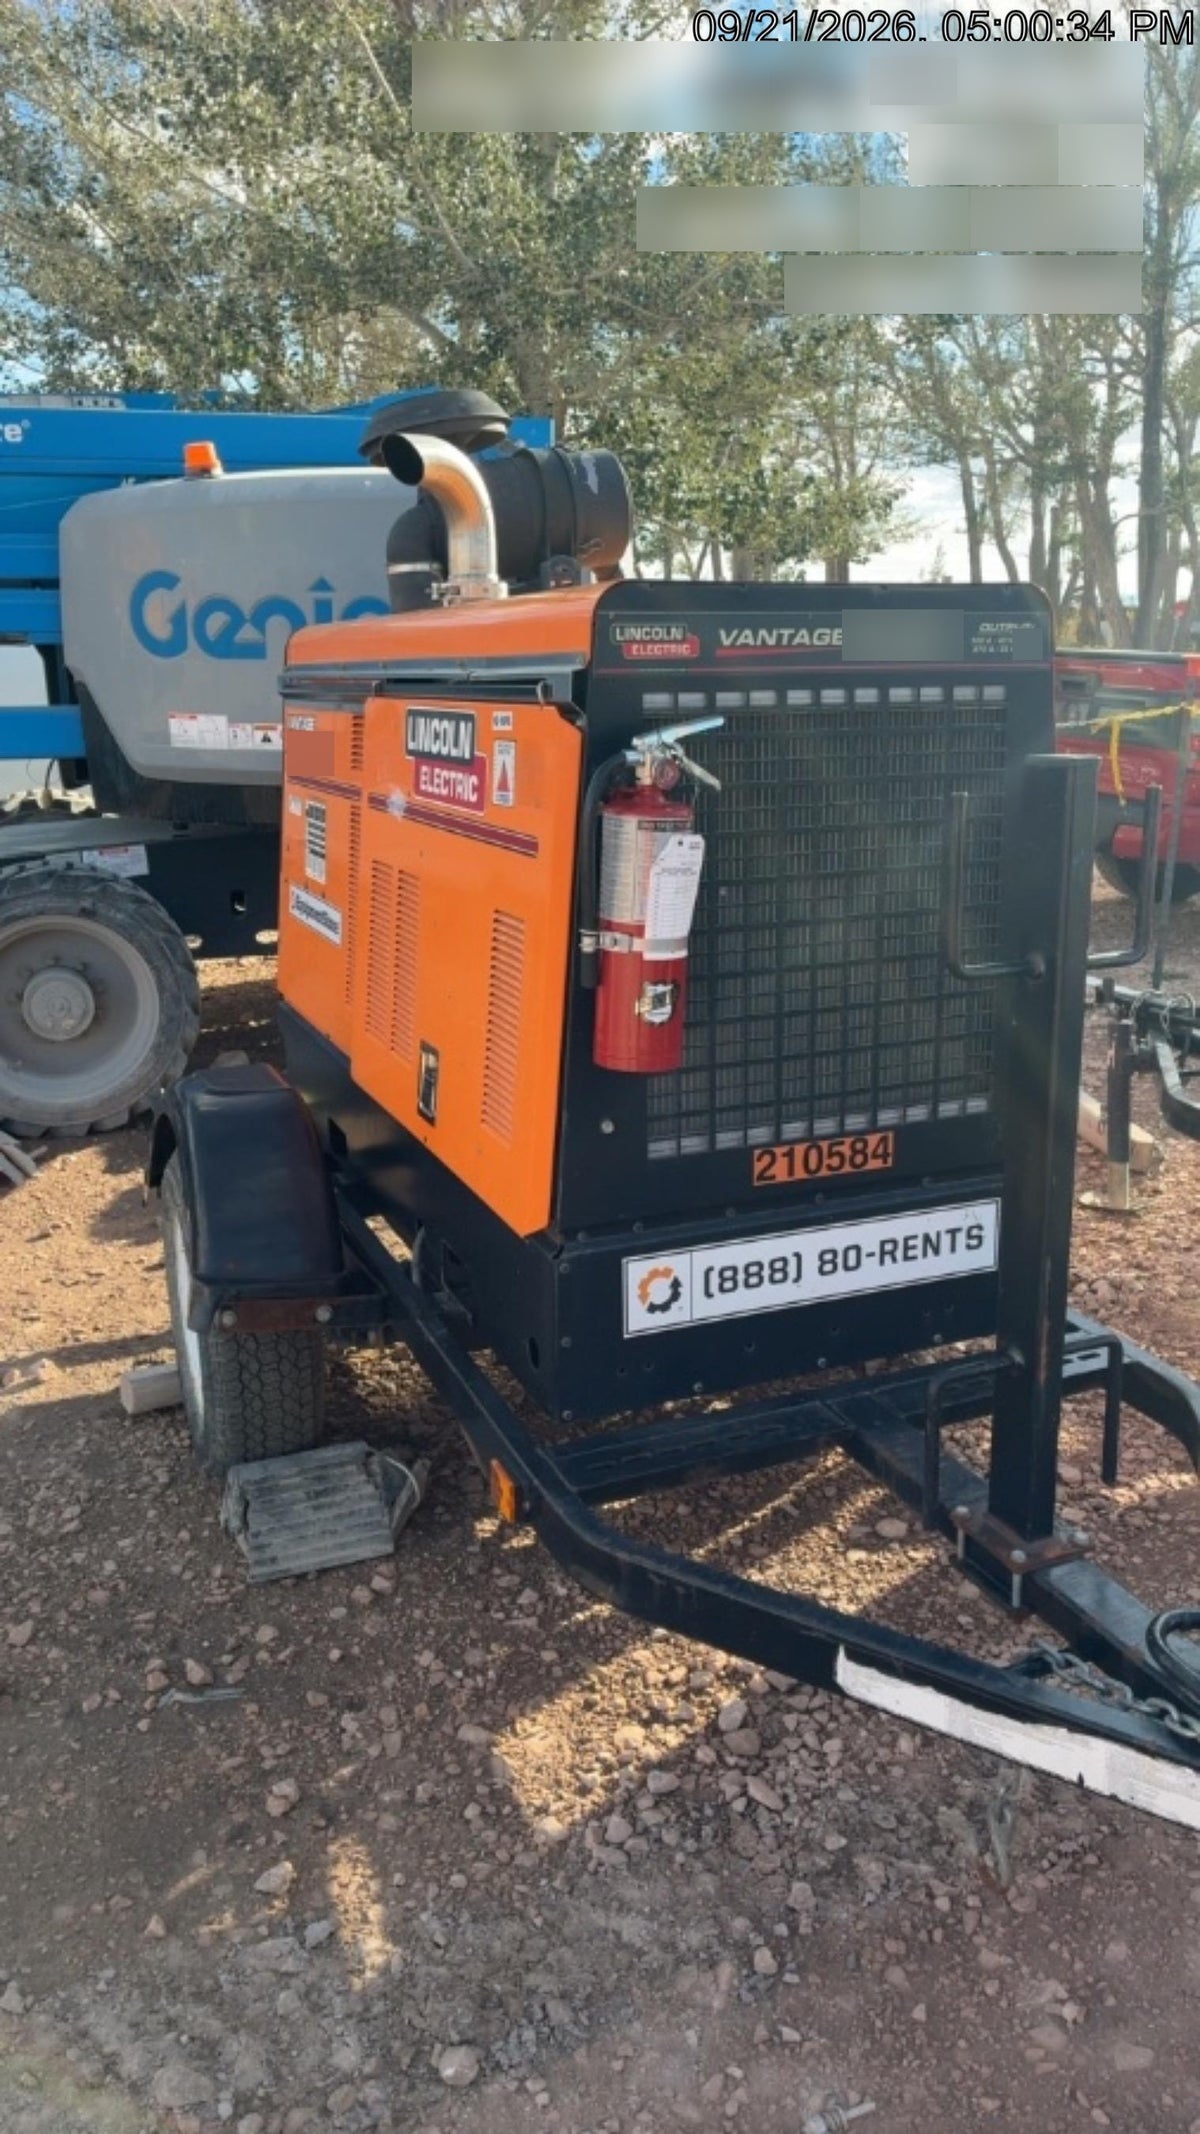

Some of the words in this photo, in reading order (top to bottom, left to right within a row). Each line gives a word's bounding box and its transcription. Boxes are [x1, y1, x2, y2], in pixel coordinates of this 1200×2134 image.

[615, 626, 685, 642] LINCOLN
[631, 643, 692, 657] ELECTRIC
[718, 627, 843, 647] VANTAGE
[407, 715, 473, 760] LINCOLN
[419, 765, 479, 803] ELECTRIC
[754, 1134, 891, 1183] 210584
[703, 1252, 802, 1298] (888)
[817, 1223, 984, 1276] 80-RENTS
